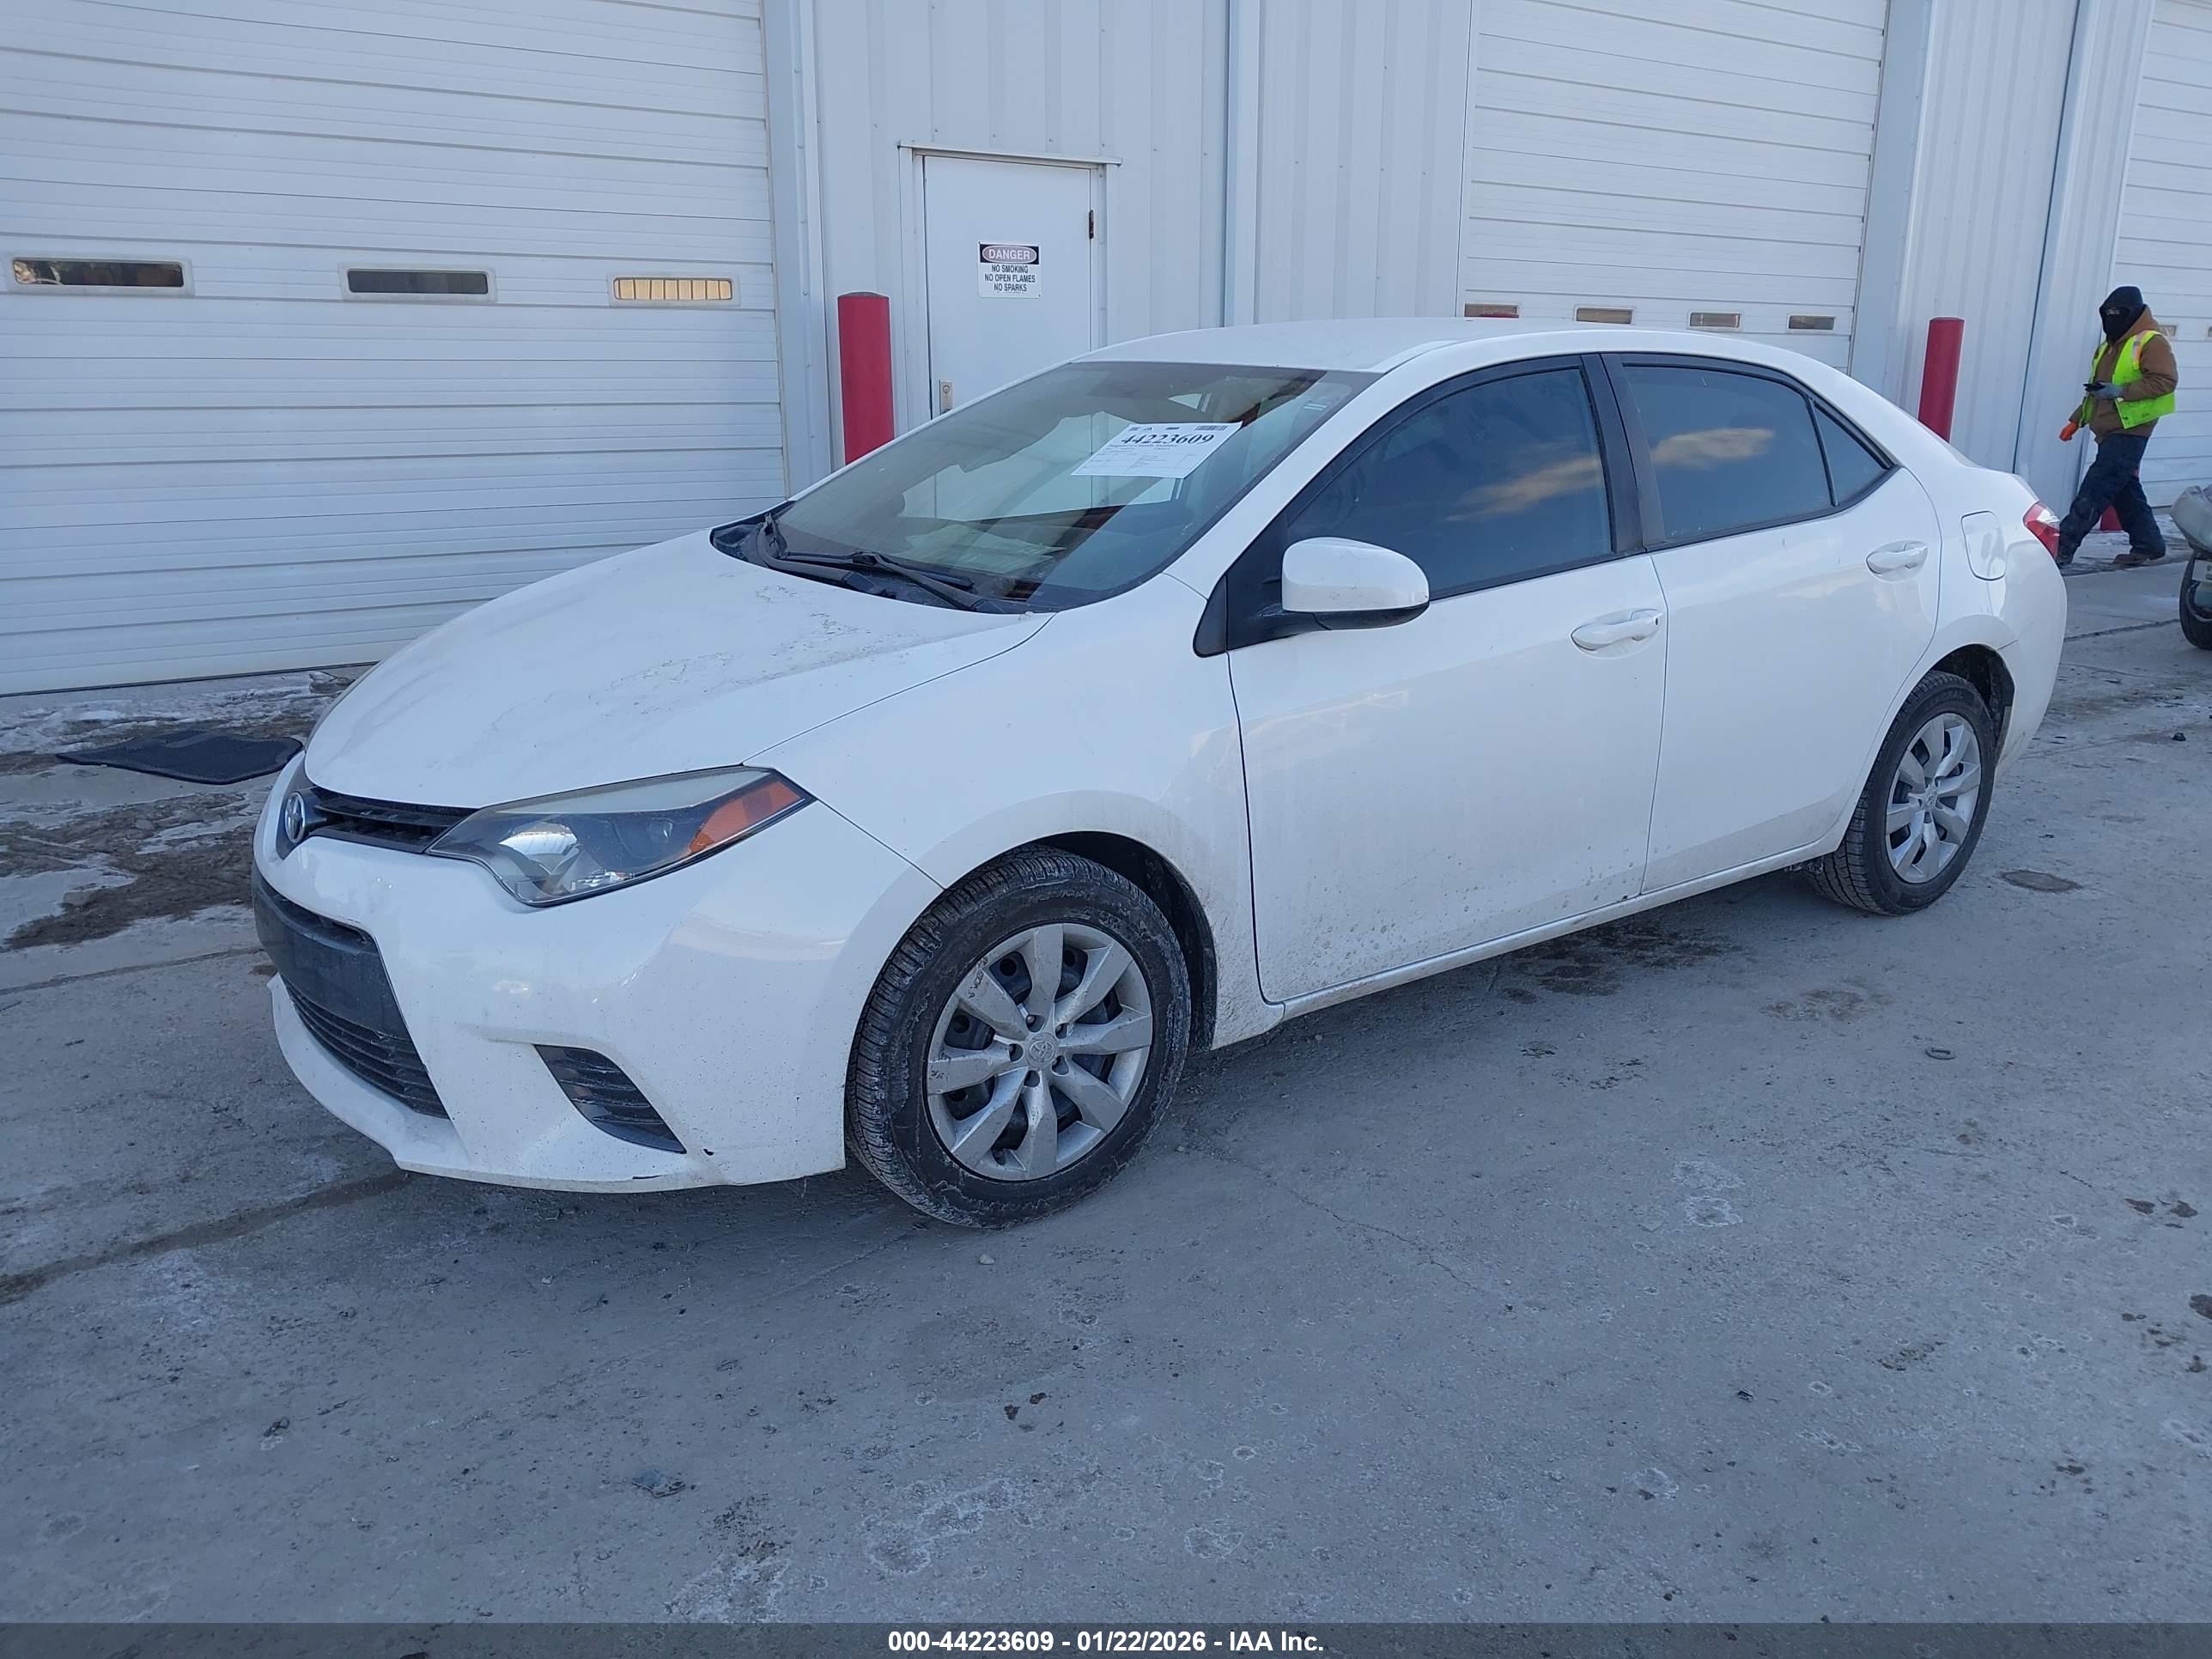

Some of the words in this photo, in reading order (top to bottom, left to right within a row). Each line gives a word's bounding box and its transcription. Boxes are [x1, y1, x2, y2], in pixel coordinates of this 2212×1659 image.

[988, 249, 1030, 260] DANGER
[992, 264, 1000, 273] NO
[1001, 264, 1029, 273] SMOKING
[1012, 275, 1036, 283] FLAMES
[1004, 283, 1027, 292] SPARKS
[1121, 434, 1215, 445] 44223609
